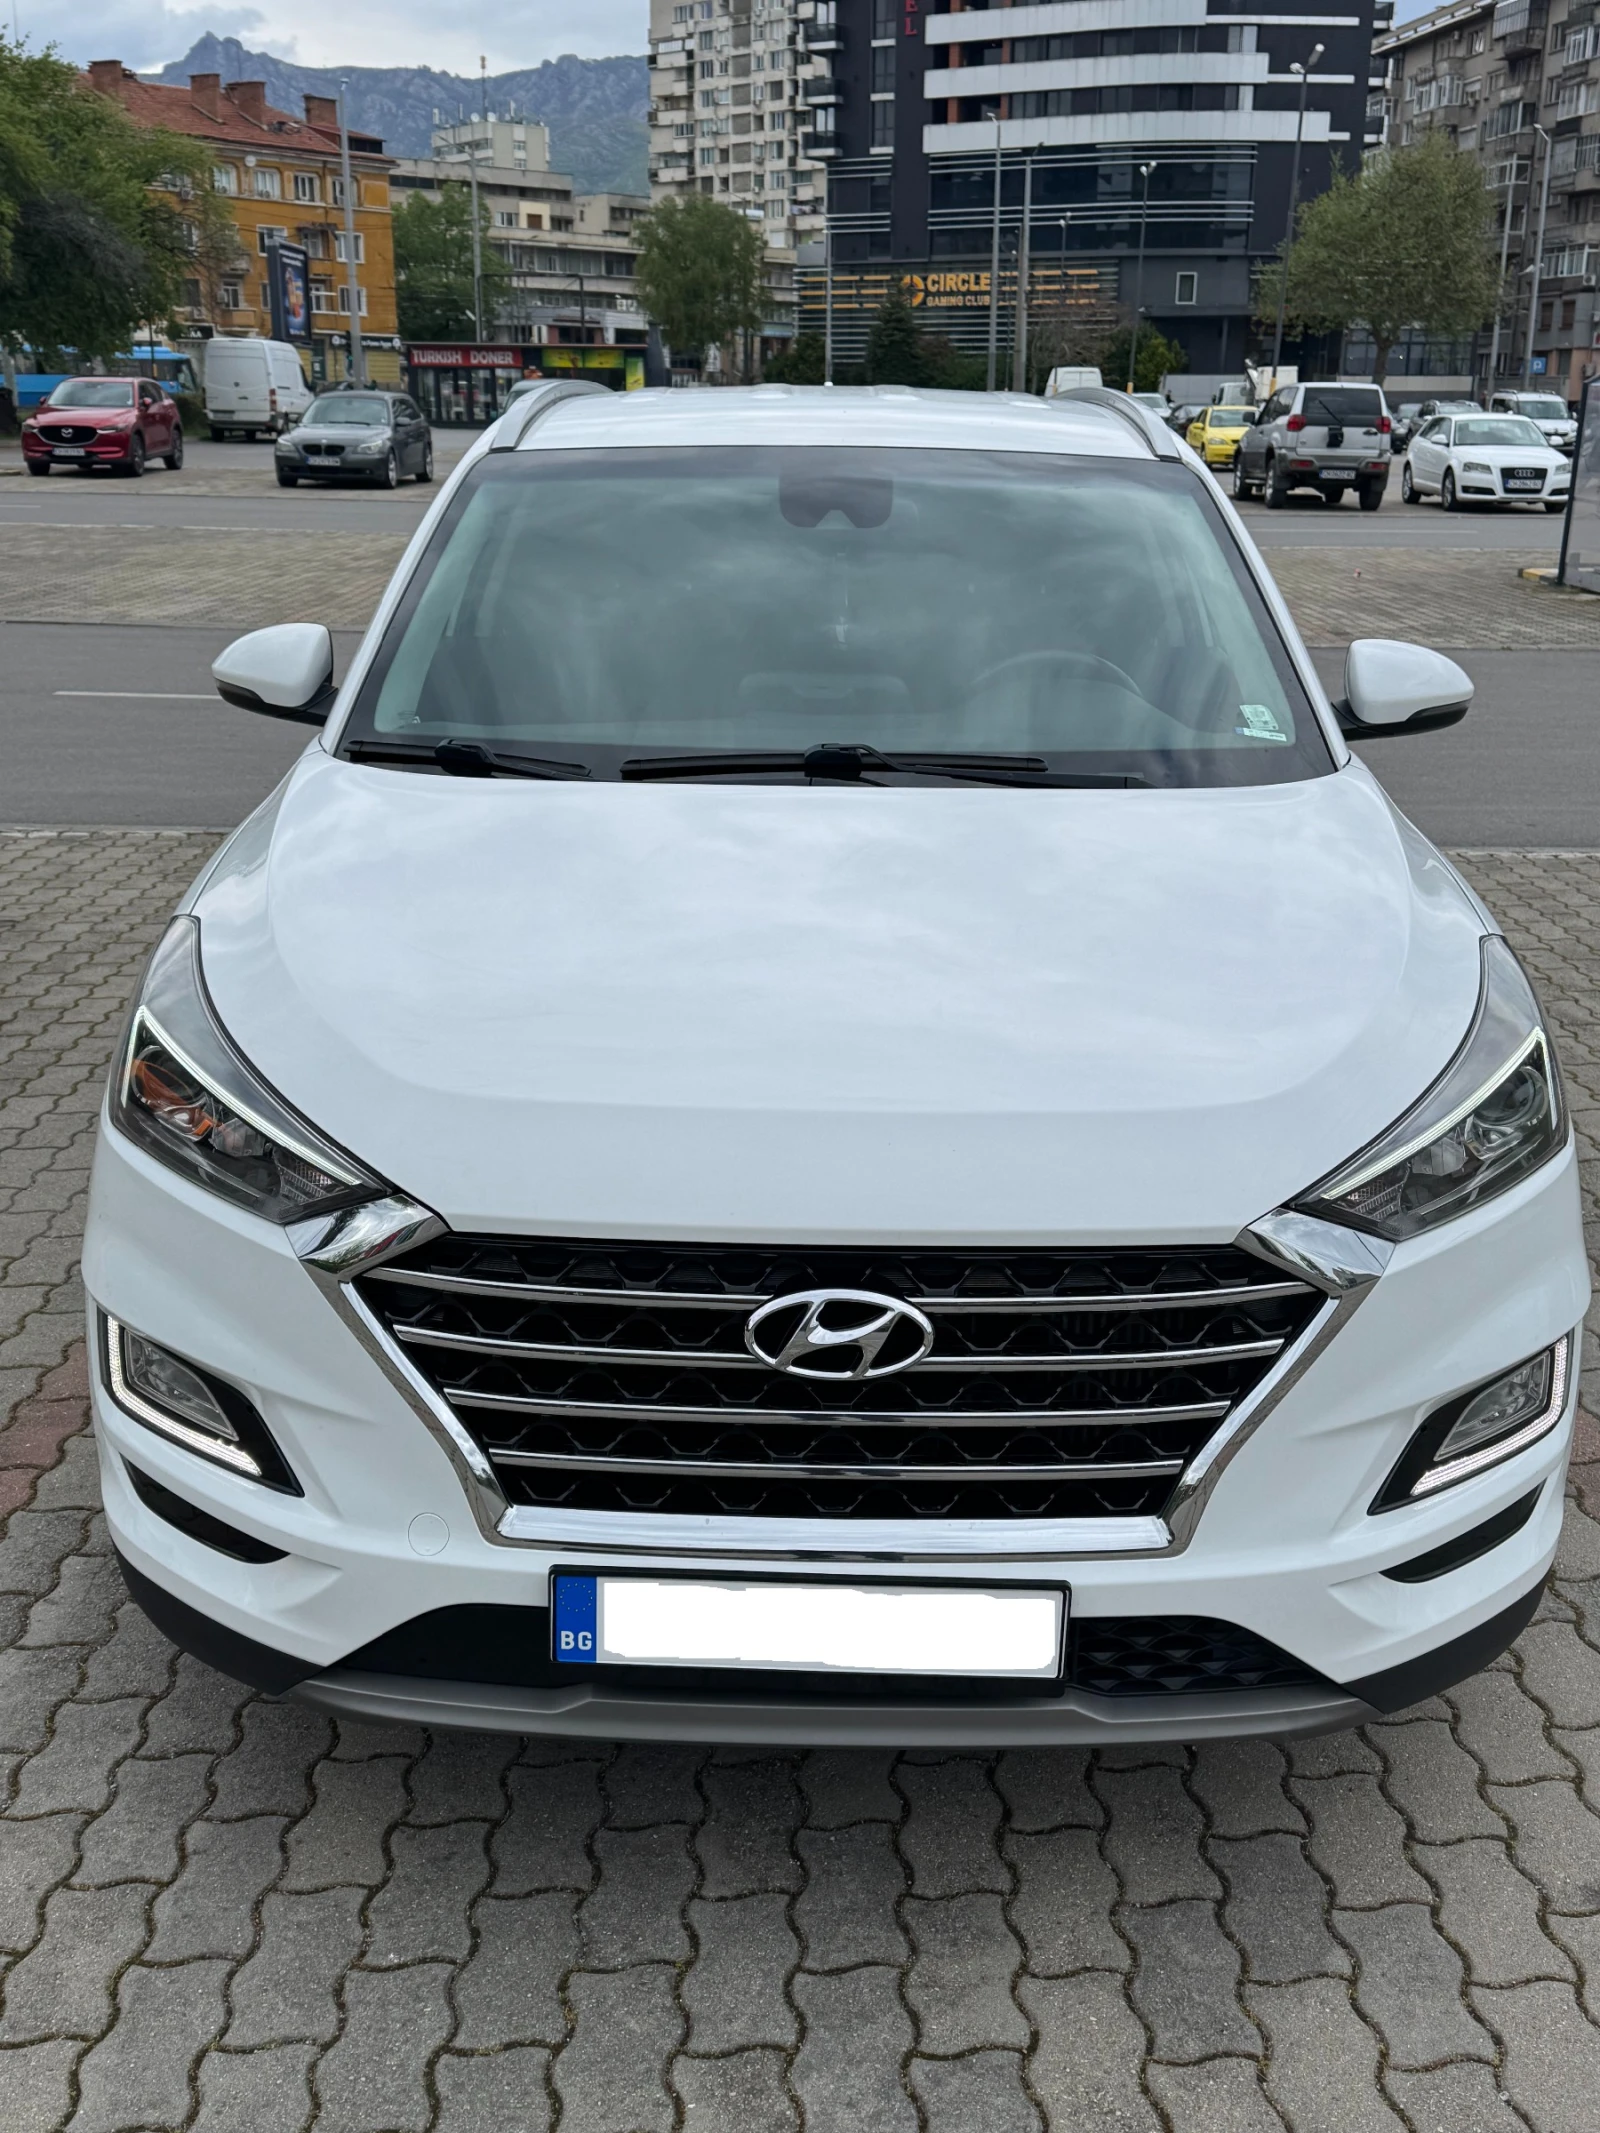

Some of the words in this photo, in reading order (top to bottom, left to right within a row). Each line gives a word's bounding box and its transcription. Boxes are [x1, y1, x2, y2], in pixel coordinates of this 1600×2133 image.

[926, 273, 991, 292] CIRCLE
[926, 295, 963, 307] GAMING
[965, 295, 991, 307] CLUB
[411, 348, 462, 364] TURKISH
[470, 350, 514, 364] DONER
[561, 1631, 592, 1650] BG
